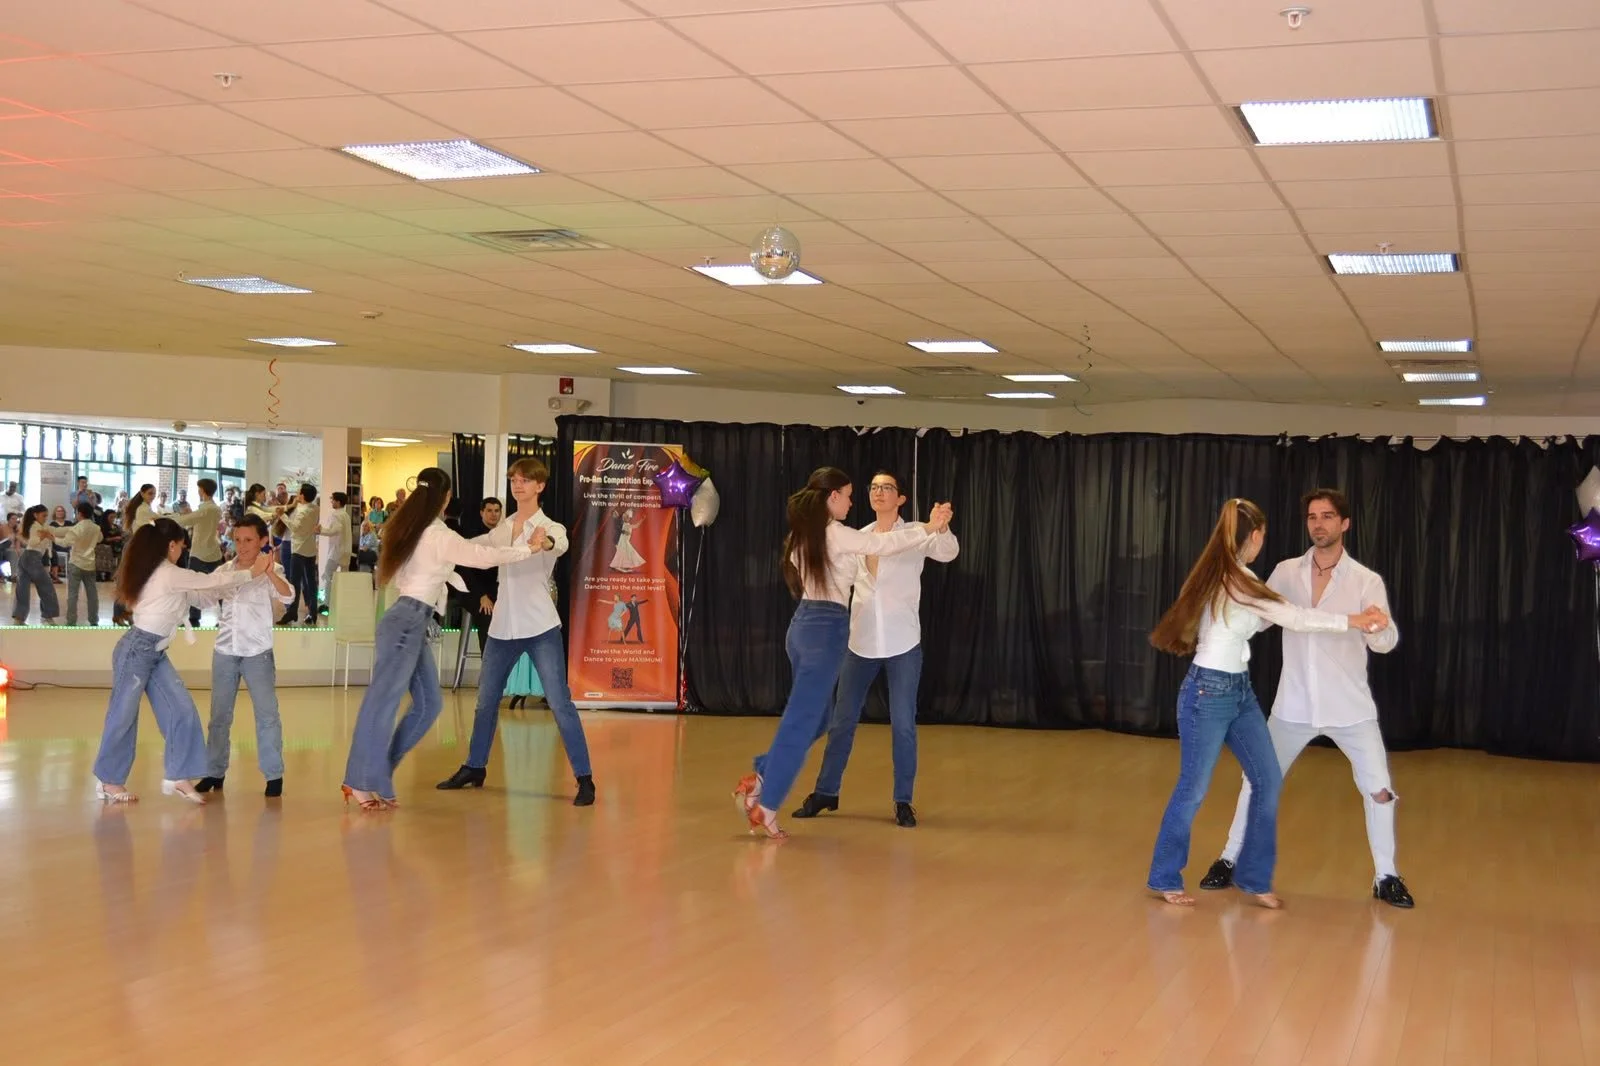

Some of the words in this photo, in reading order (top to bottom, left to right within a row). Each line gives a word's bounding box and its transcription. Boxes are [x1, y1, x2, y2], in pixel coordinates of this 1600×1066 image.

[596, 458, 634, 472] Dance
[636, 458, 659, 472] Fire
[580, 475, 602, 483] Pro-Am
[604, 476, 642, 485] Competition
